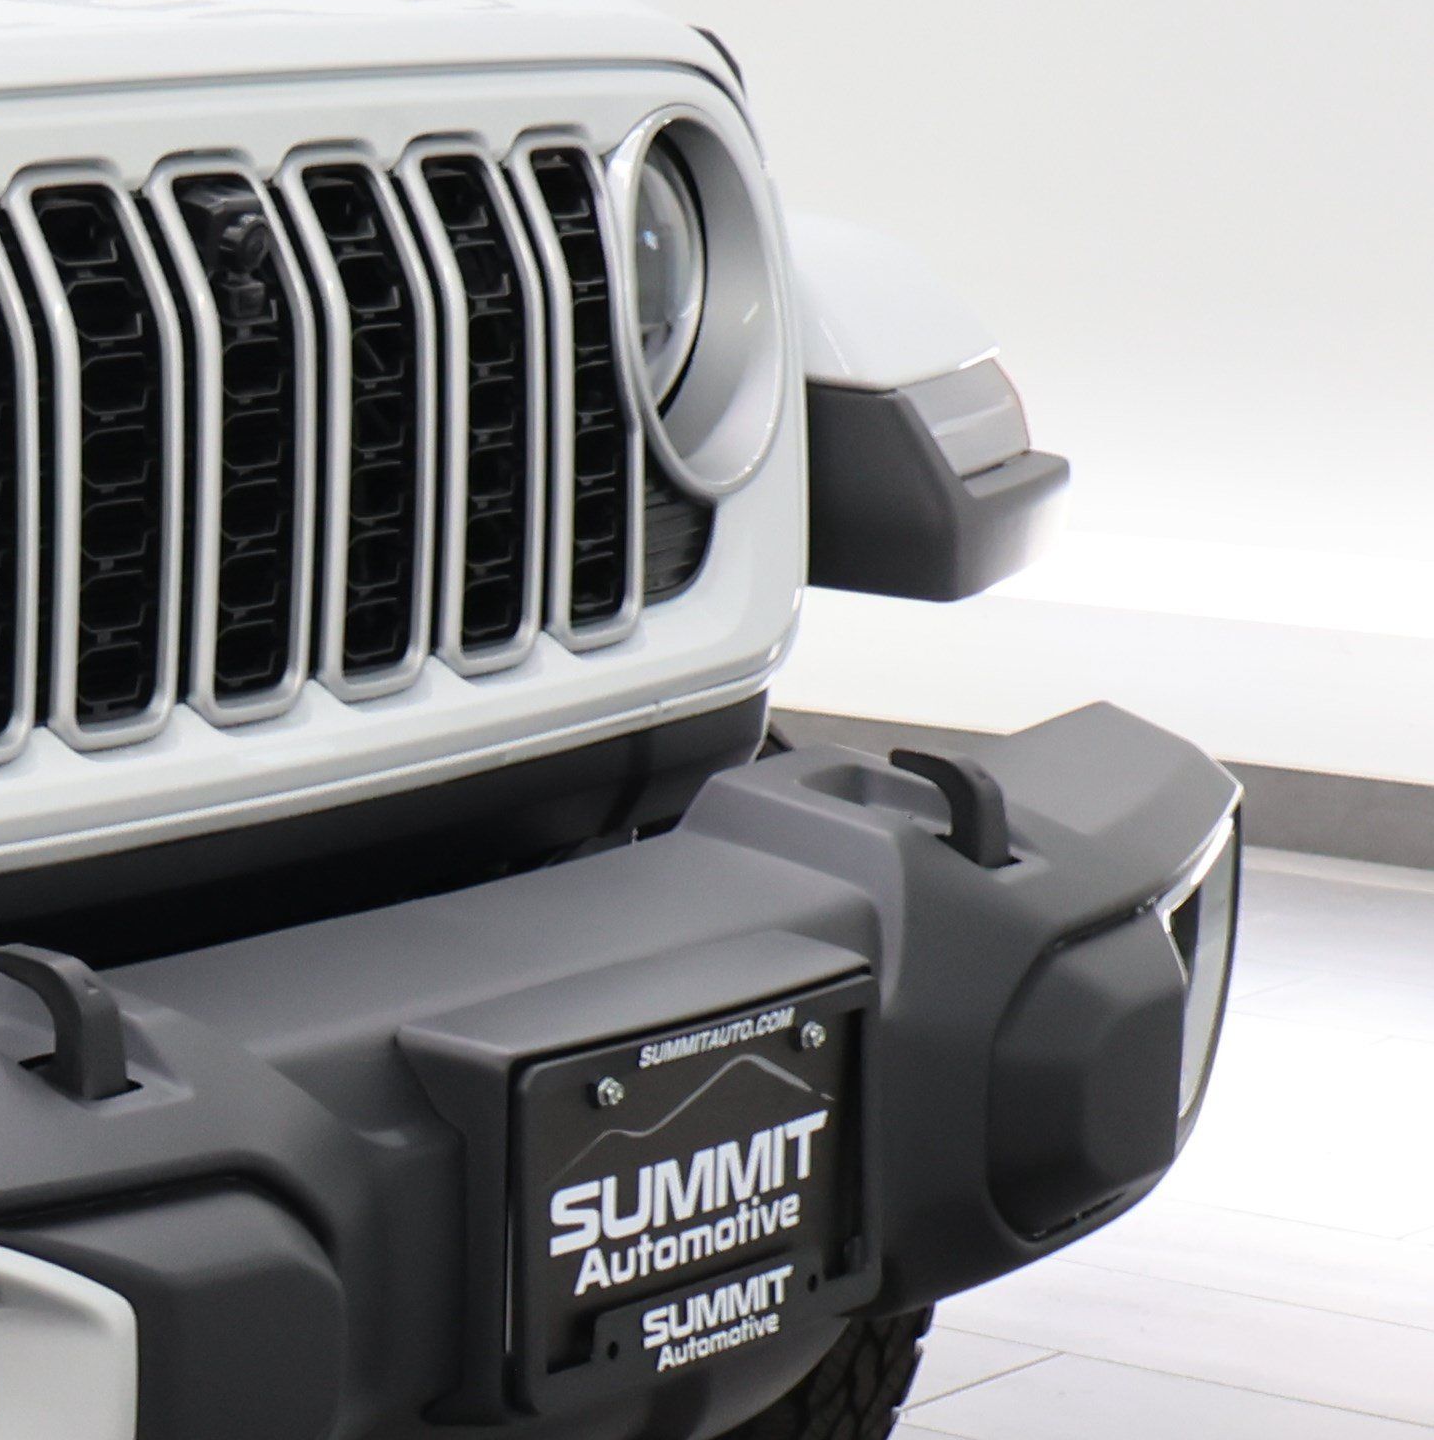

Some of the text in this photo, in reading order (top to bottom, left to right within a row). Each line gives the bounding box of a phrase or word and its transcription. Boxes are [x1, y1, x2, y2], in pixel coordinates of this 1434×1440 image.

[638, 1006, 796, 1068] SUMMITAUTO.COM
[549, 1110, 829, 1257] SUMMIT
[573, 1193, 801, 1296] Automotive
[642, 1265, 795, 1349] SUMMIT
[656, 1312, 781, 1373] Automotive
